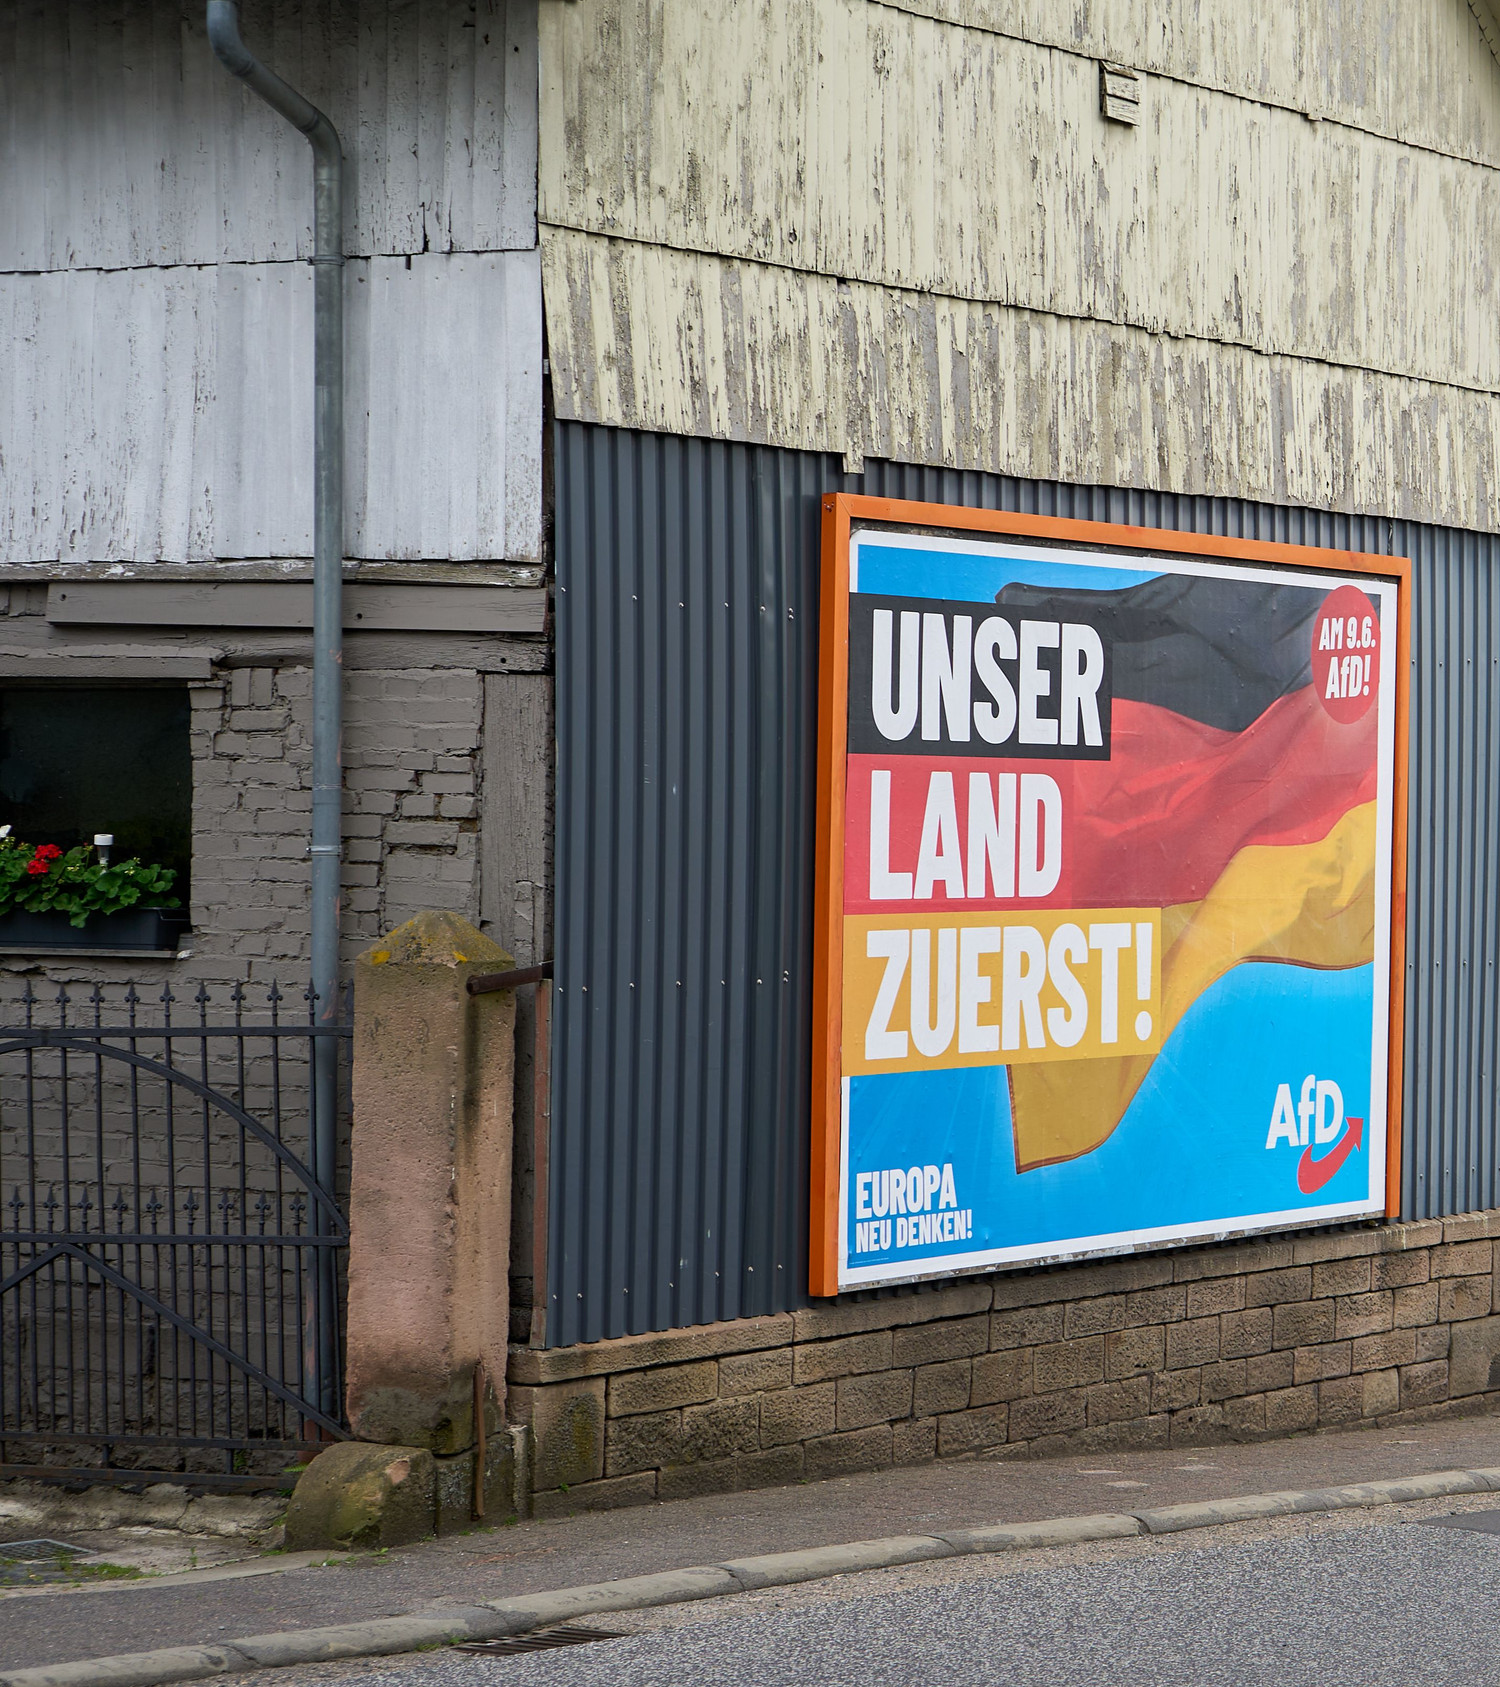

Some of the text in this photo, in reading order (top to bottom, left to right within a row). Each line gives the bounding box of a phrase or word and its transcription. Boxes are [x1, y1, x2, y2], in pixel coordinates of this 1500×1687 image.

[1318, 616, 1376, 650] AM 9.6.
[872, 609, 1104, 746] UNSER
[1325, 654, 1371, 699] AfD!
[869, 770, 1062, 899] LAND
[865, 922, 1153, 1060] ZUERST!
[1265, 1074, 1344, 1150] AfD
[856, 1163, 957, 1219] EUROPA
[856, 1209, 973, 1253] NEU DENKEN!
